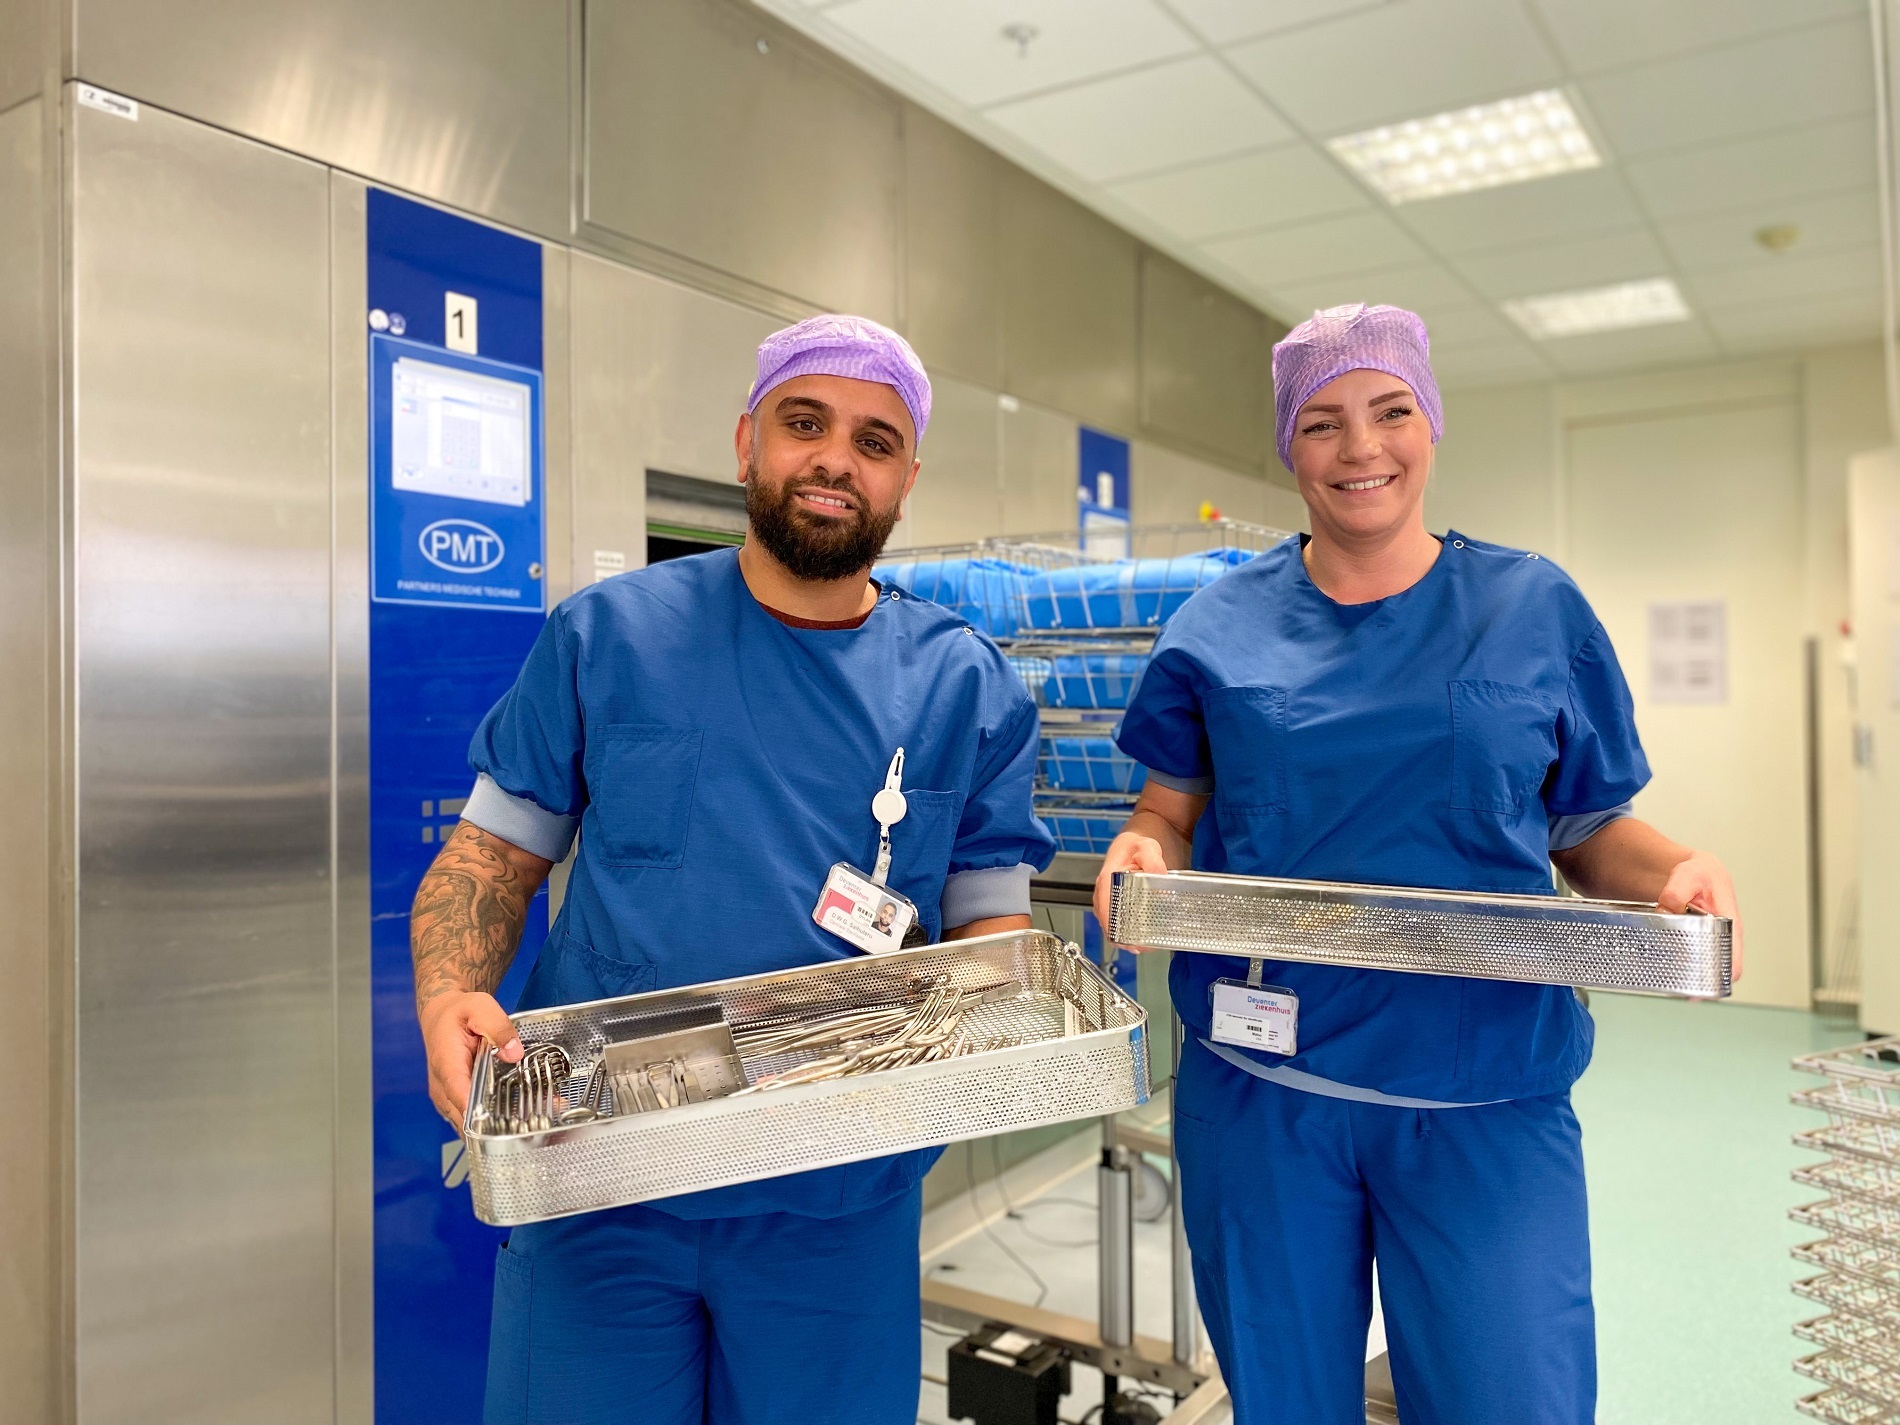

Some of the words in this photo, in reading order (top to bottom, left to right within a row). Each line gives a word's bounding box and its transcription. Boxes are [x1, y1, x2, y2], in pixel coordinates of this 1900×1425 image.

[452, 309, 464, 339] 1
[431, 530, 494, 564] PMT
[397, 580, 442, 593] PARTNERS
[1247, 995, 1278, 1007] Deventer
[1255, 1003, 1291, 1015] ziekenhuis
